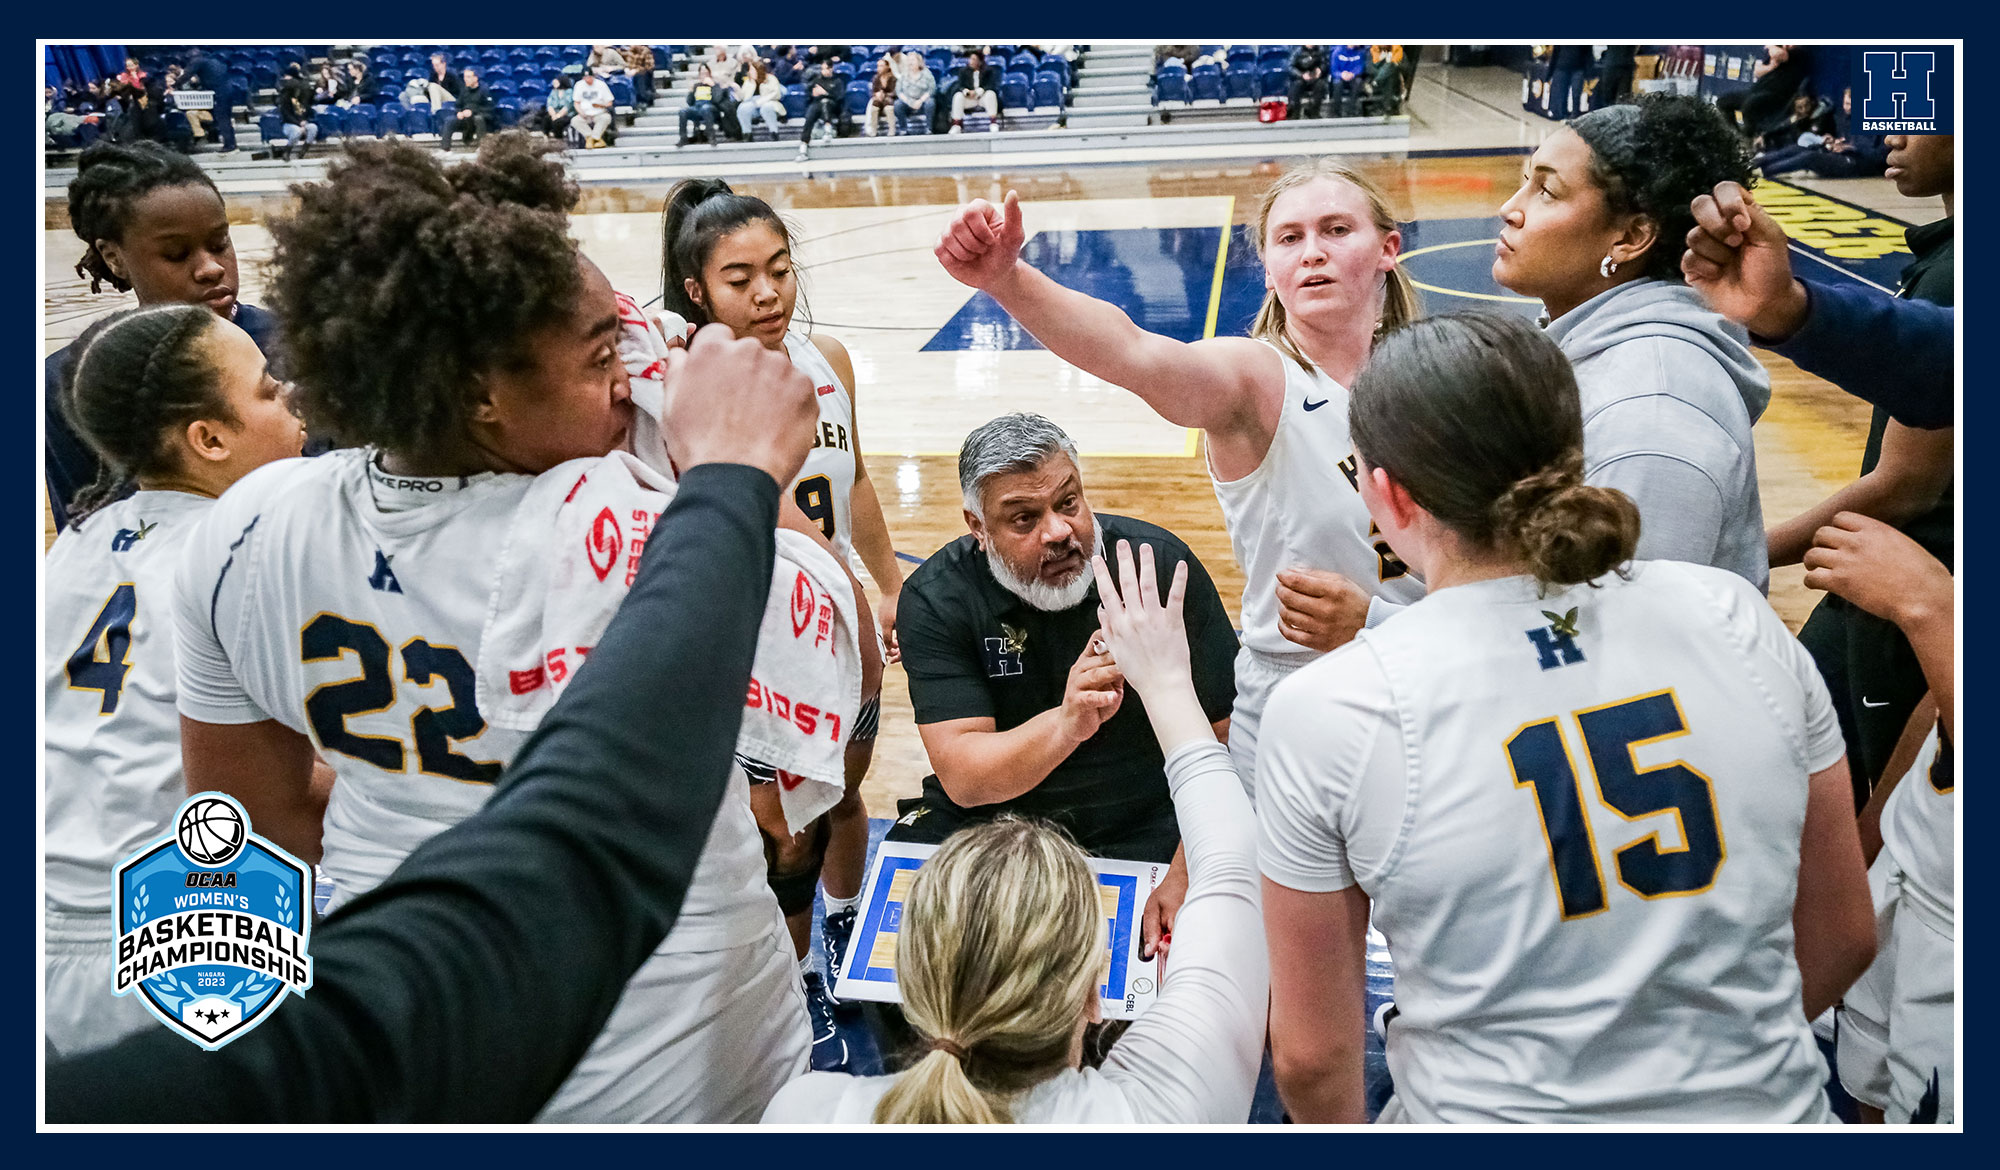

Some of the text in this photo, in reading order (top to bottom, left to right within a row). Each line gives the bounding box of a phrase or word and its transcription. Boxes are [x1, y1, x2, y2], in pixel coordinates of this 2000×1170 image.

[398, 480, 443, 493] PRO
[792, 473, 835, 542] 9
[65, 582, 137, 716] 4
[300, 611, 505, 786] 22
[1502, 687, 1728, 922] 15
[1125, 993, 1135, 1013] CEBL
